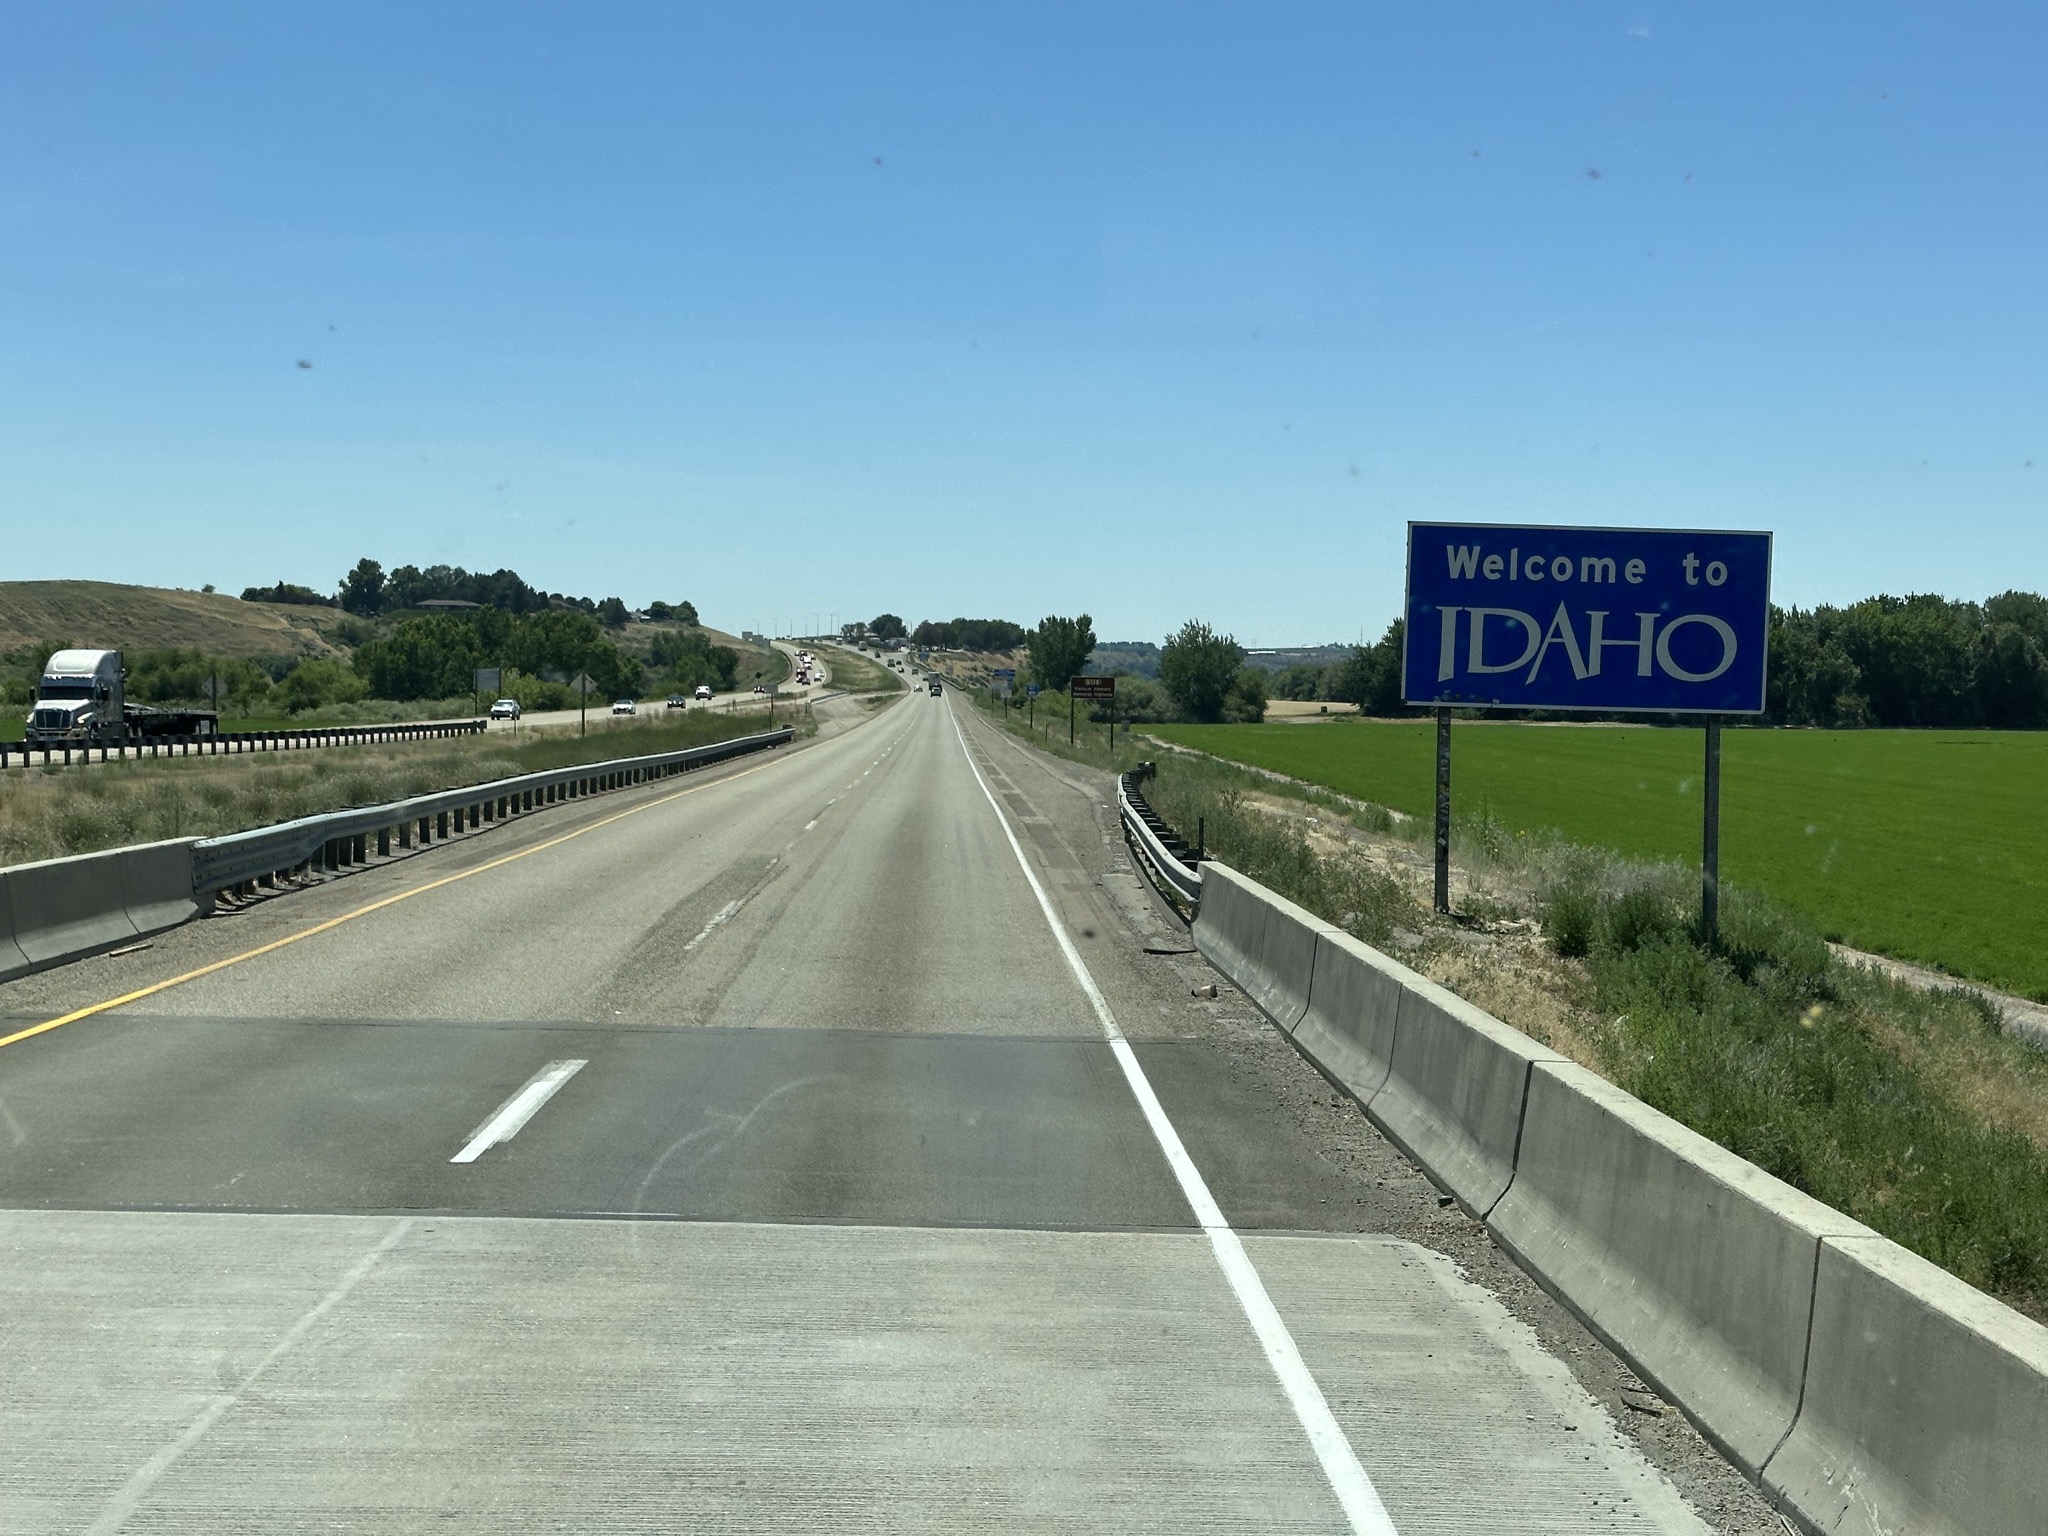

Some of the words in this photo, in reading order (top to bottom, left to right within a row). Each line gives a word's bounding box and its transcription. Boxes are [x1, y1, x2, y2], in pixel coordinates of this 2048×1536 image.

[1446, 545, 1647, 584] Welcome
[1683, 552, 1729, 587] to
[1436, 600, 1738, 685] IDAHO
